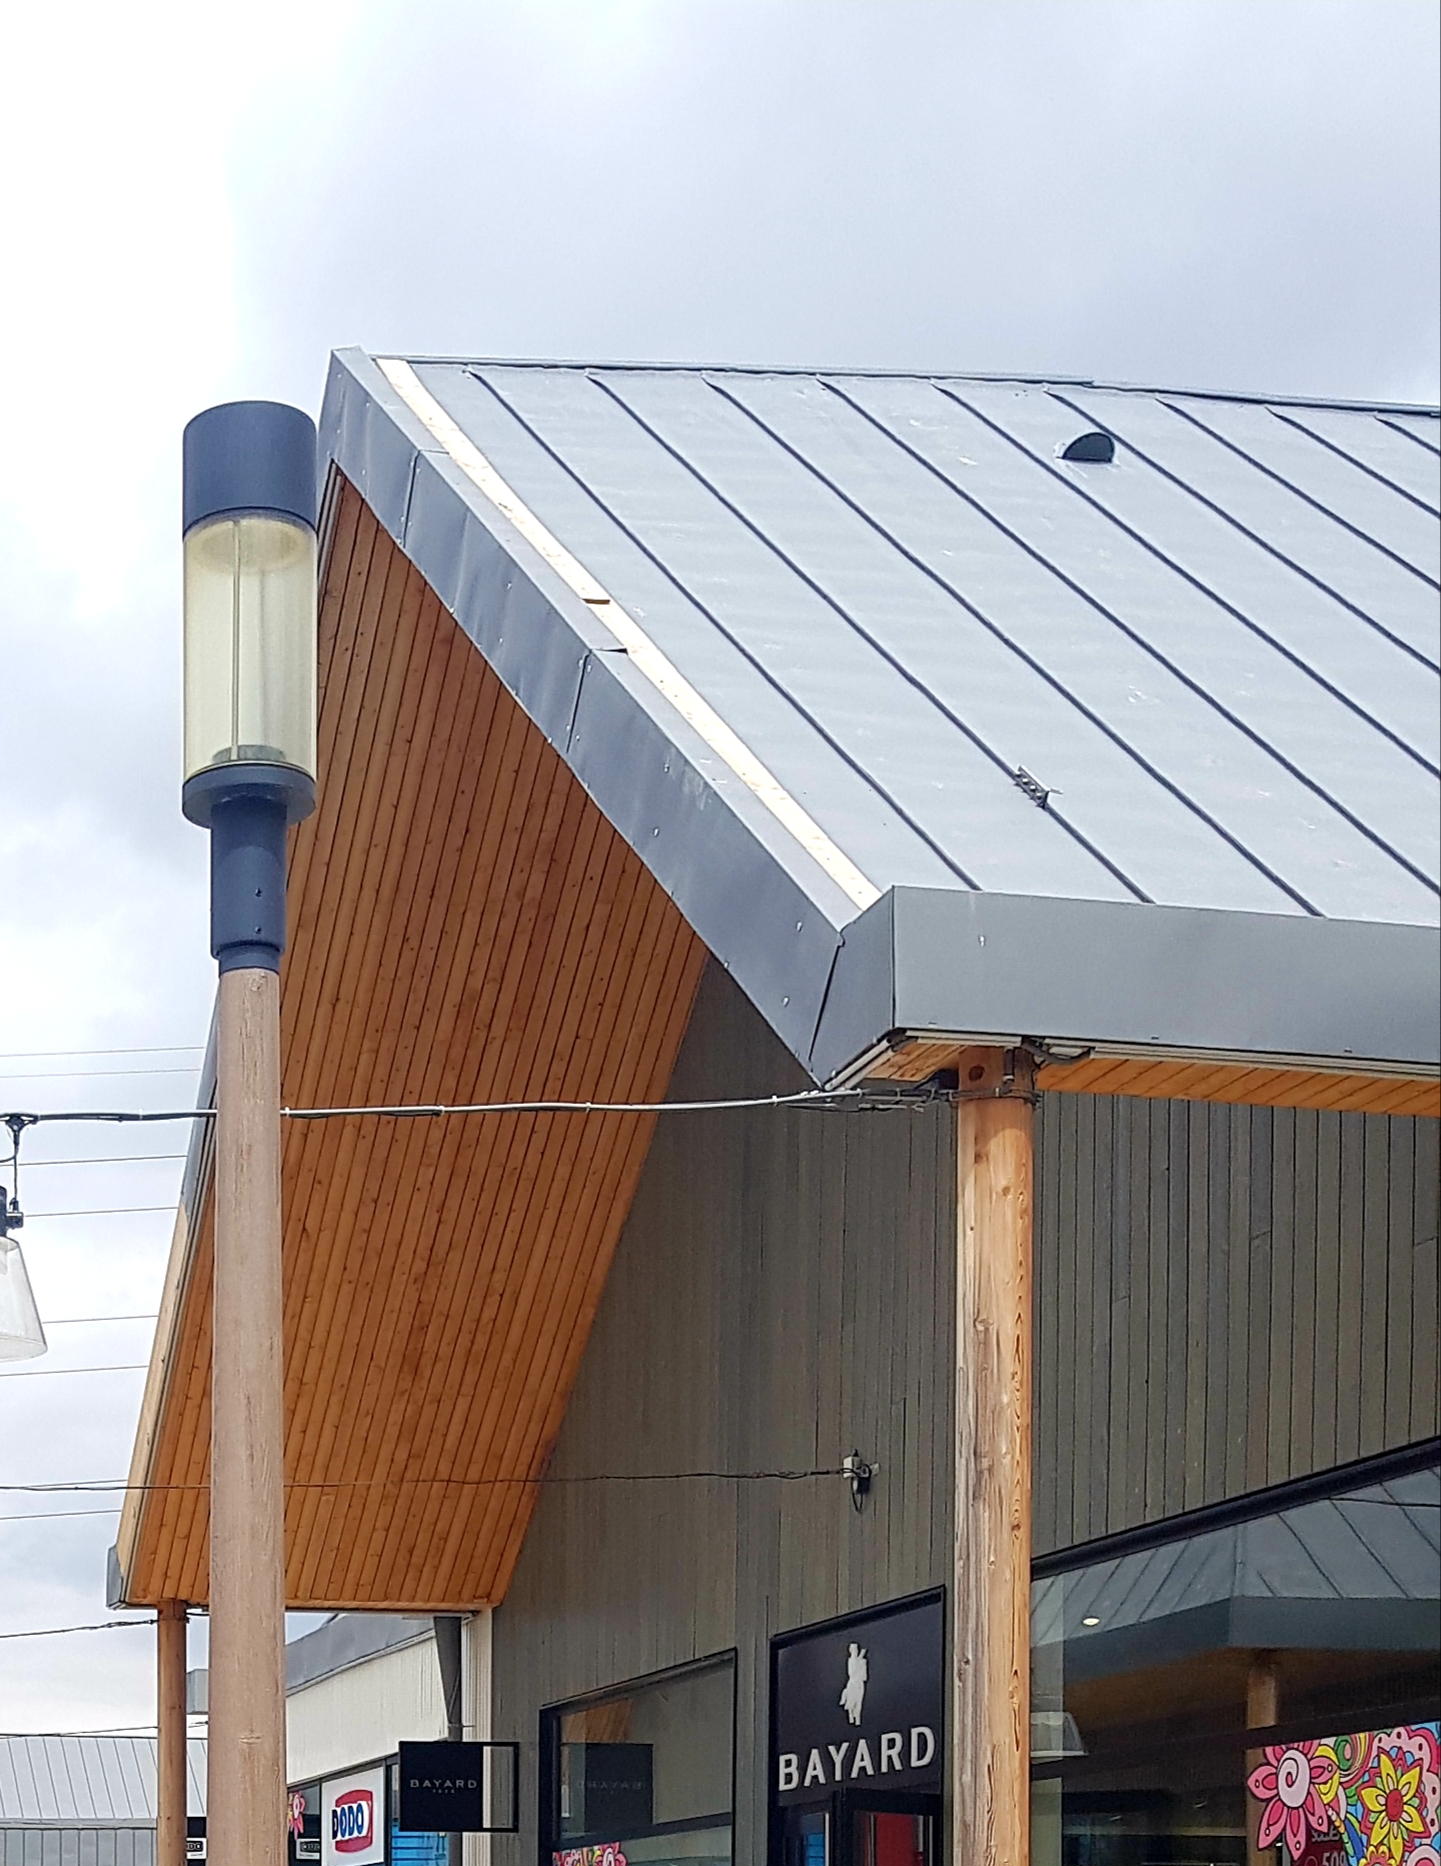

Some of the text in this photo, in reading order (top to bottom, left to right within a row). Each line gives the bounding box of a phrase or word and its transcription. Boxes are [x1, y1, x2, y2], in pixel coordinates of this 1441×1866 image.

[778, 1726, 936, 1791] BAYARD
[409, 1779, 477, 1789] BAYARD
[331, 1802, 365, 1840] DODO
